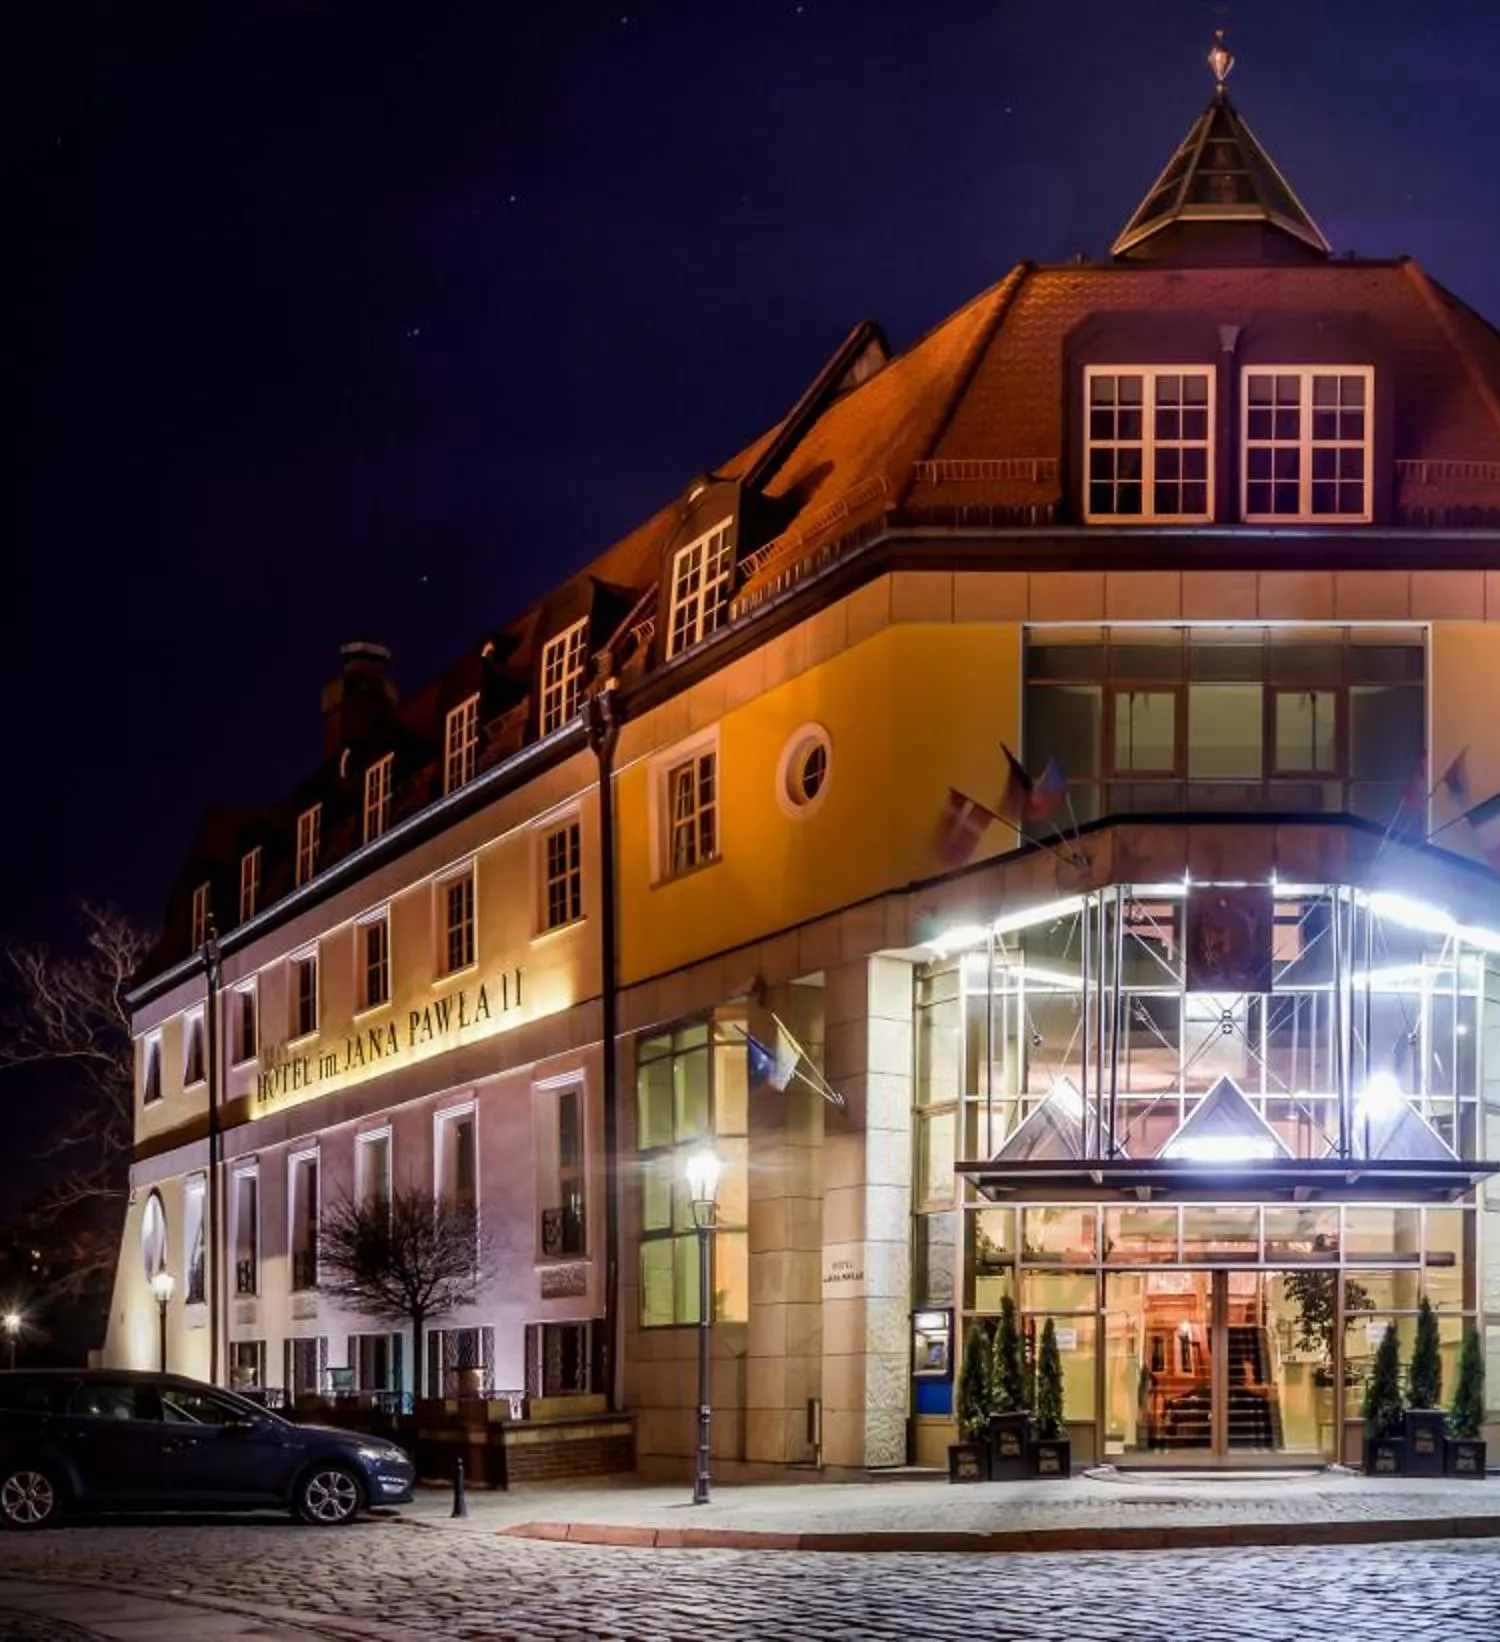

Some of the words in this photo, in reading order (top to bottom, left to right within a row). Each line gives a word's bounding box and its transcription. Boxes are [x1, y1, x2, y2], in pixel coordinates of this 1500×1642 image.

[257, 1056, 312, 1102] HOTEL
[345, 1021, 399, 1071] JANA
[409, 983, 490, 1047] PAWŁA
[501, 968, 522, 1011] II
